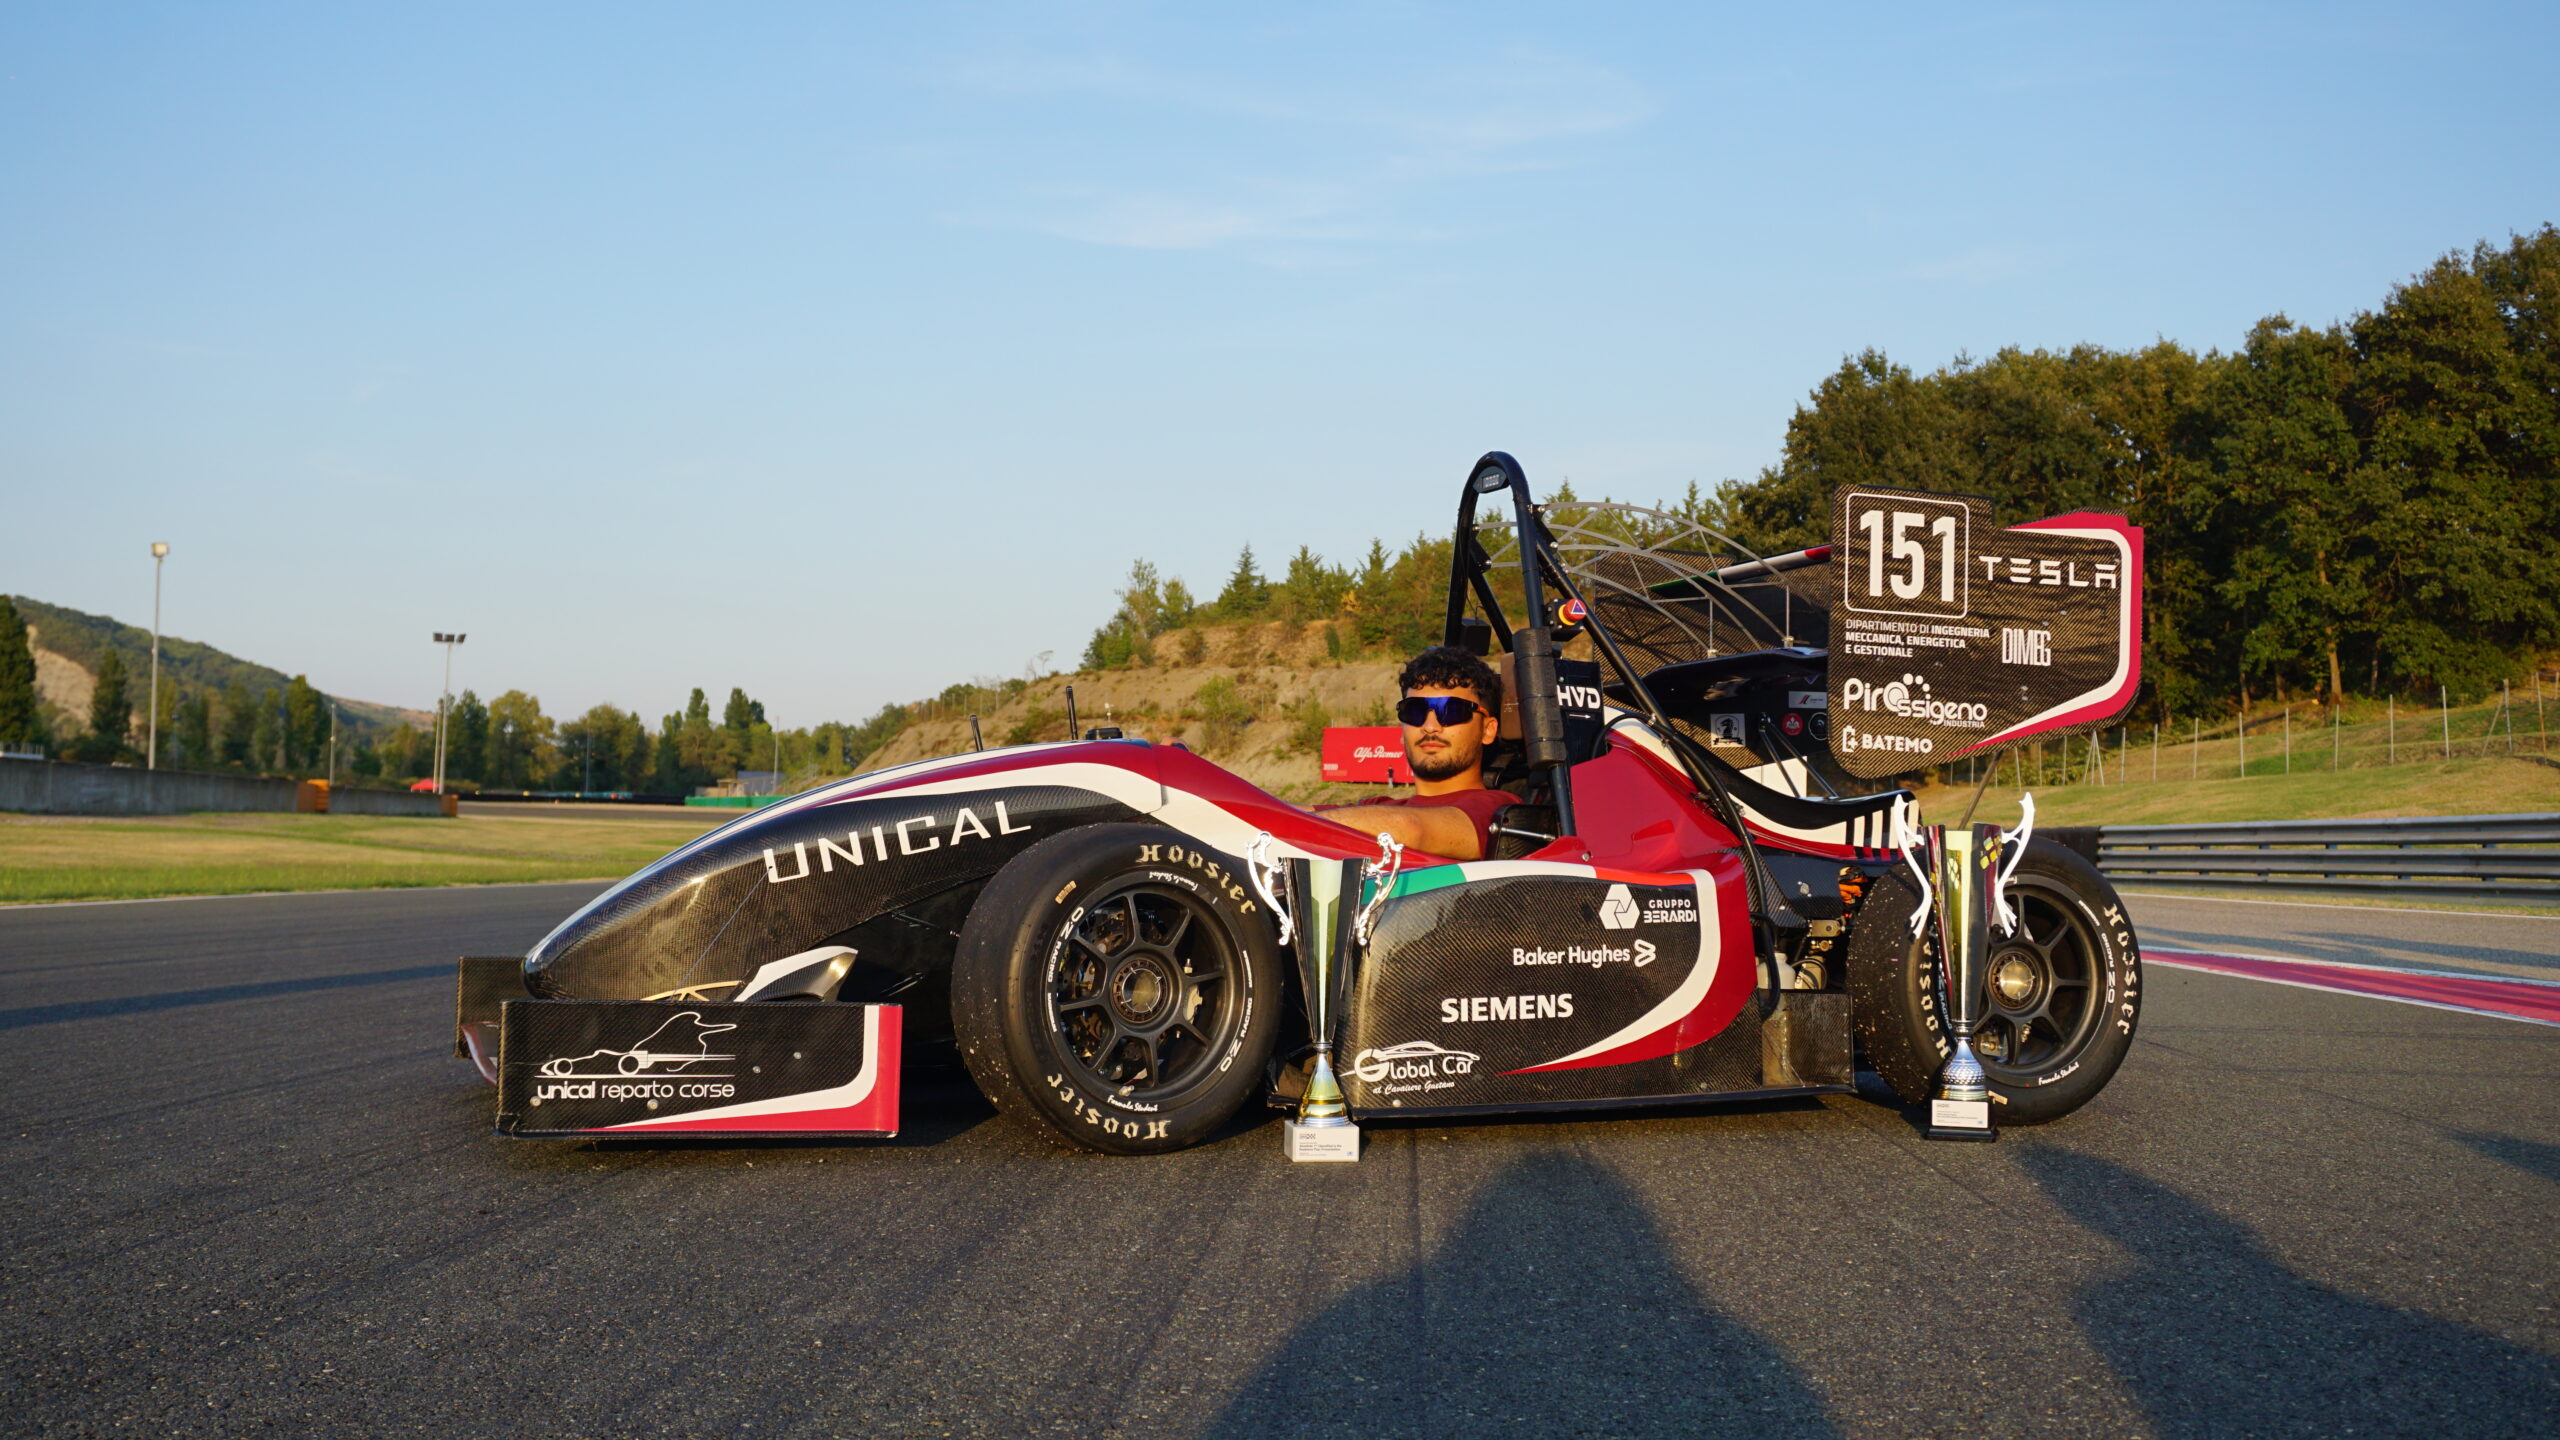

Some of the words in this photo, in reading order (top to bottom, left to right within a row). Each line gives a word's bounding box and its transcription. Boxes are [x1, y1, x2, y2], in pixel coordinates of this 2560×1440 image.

[1860, 509, 1956, 602] 151
[1979, 555, 2117, 589] TESLA
[1845, 619, 1918, 633] DIPARTIMENTO
[1919, 624, 1929, 634] DI
[1931, 624, 1990, 638] INGEGNERIA
[1845, 631, 1905, 646] MECCANICA,
[1906, 635, 1966, 649] ENERGETICA
[1845, 644, 1852, 654] E
[1853, 644, 1914, 658] GESTIONALE
[2002, 627, 2051, 667] DIMEG
[1556, 684, 1601, 709] HVD
[1943, 720, 1985, 728] INDUSTRIA
[1862, 733, 1933, 753] BATEMO
[763, 800, 1032, 884] UNICAL
[1136, 844, 1257, 914] Hoosier
[1643, 909, 1697, 924] BERARDI
[1649, 899, 1691, 909] GRUPPO
[1513, 946, 1565, 966] Baker
[1568, 944, 1631, 969] Hughes
[2103, 903, 2137, 1035] Hoosier
[1441, 993, 1574, 1023] SIEMENS
[1354, 1048, 1437, 1083] Global
[1442, 1056, 1475, 1075] Car
[537, 1081, 596, 1100] unical
[601, 1080, 674, 1102] reparto
[679, 1084, 735, 1099] corse
[1047, 1073, 1172, 1140] Hoosier
